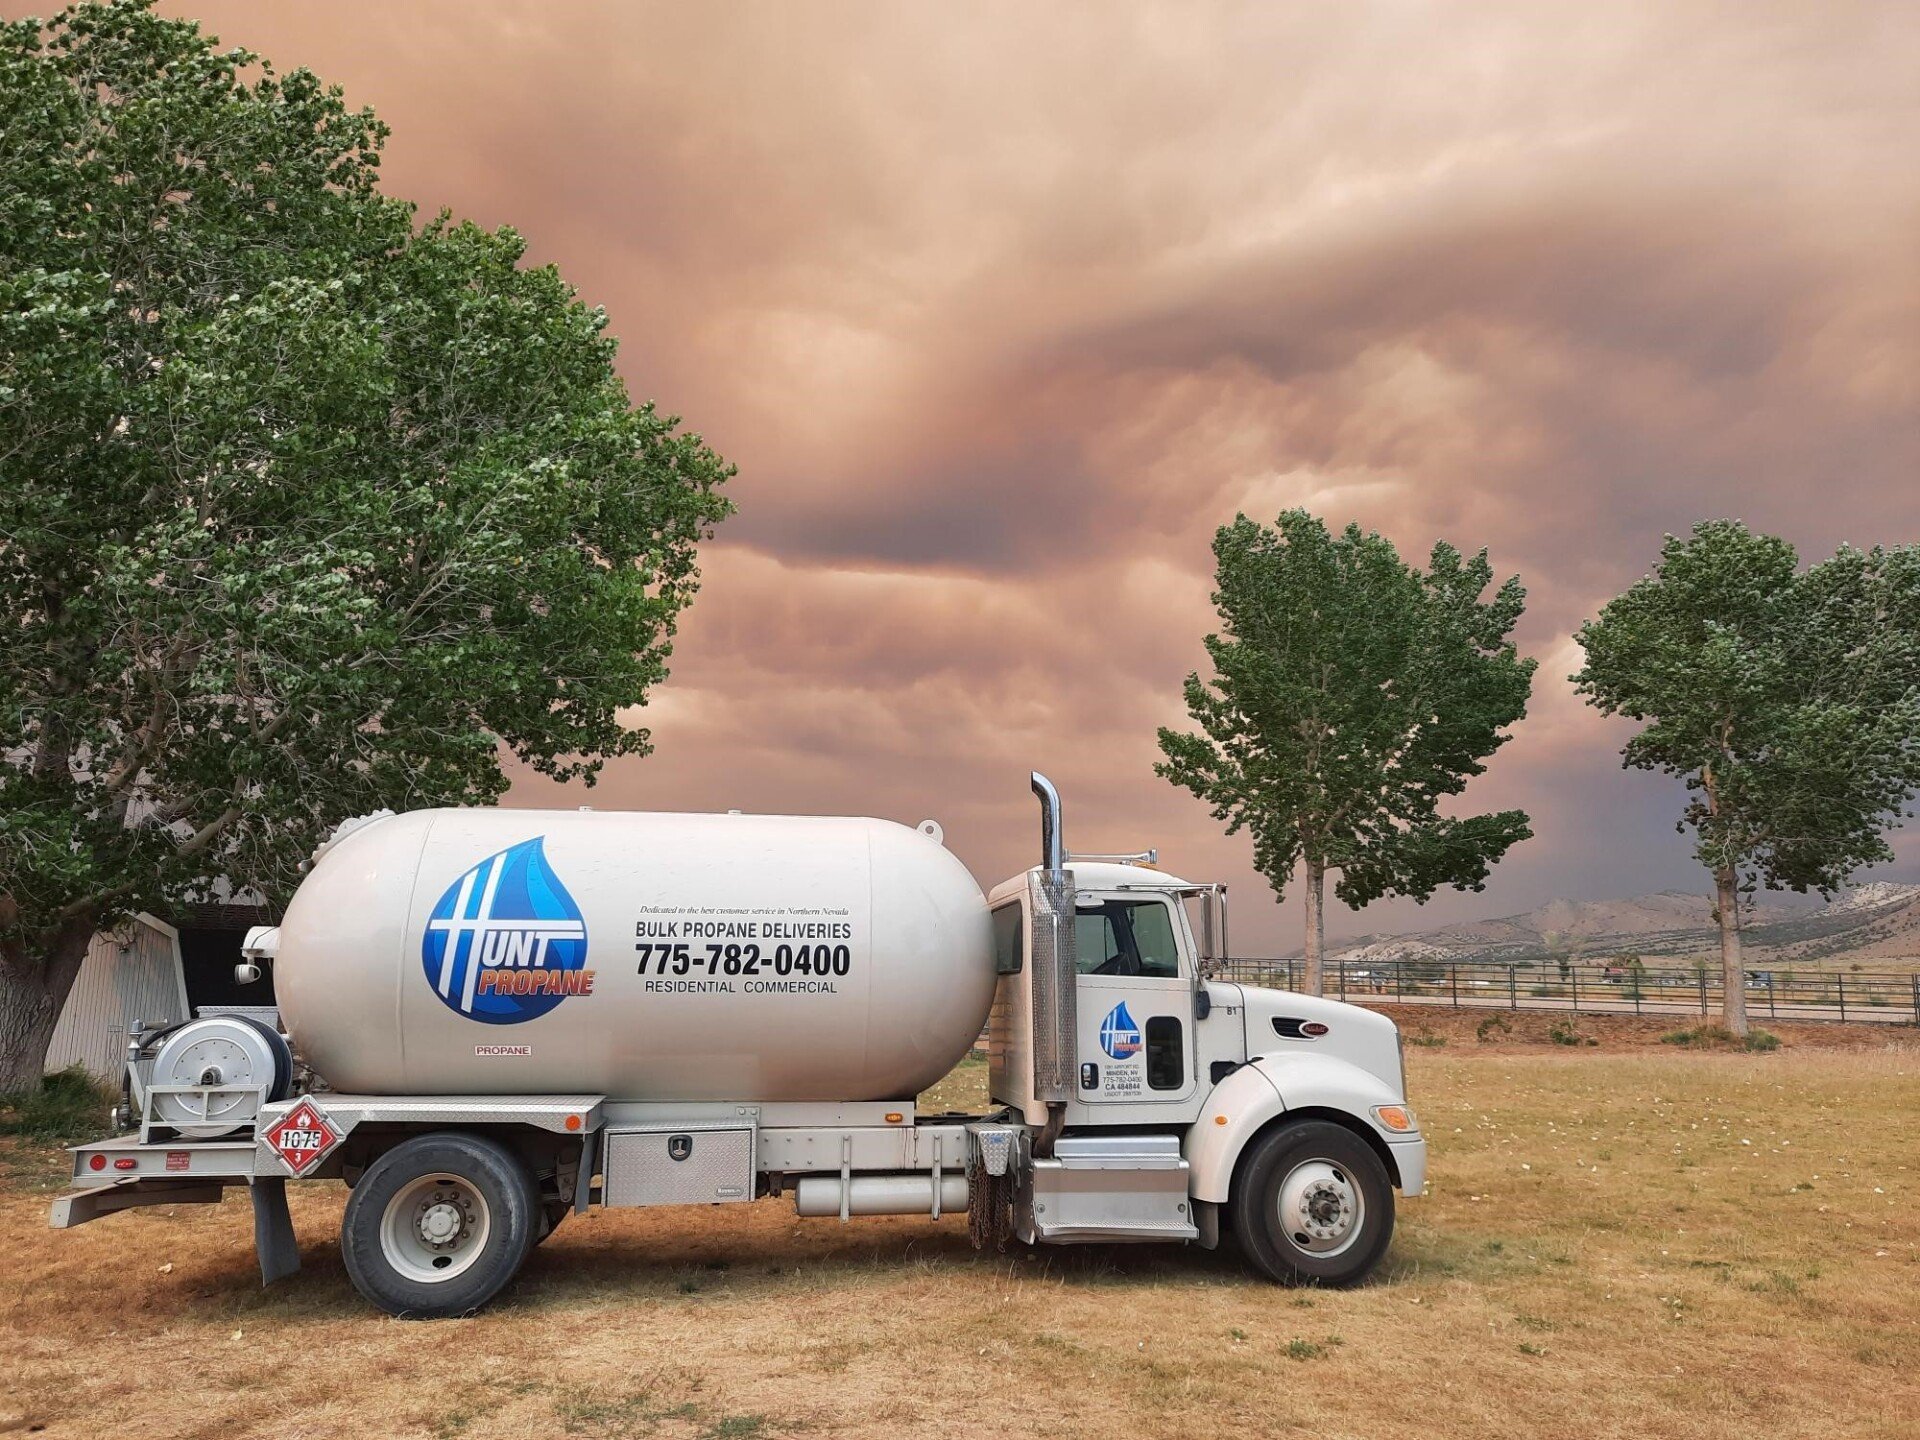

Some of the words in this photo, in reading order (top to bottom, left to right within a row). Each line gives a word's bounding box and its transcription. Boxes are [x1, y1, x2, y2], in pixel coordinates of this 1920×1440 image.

[640, 905, 678, 914] Dedicated
[678, 906, 686, 914] to
[687, 906, 700, 914] the
[700, 906, 715, 914] best
[751, 907, 776, 915] service
[787, 907, 820, 915] Northern
[821, 907, 849, 916] Nevada
[429, 851, 584, 1013] HUNT
[636, 921, 678, 937] BULK
[683, 922, 757, 938] PROPANE
[762, 923, 851, 939] DELIVERIES
[635, 943, 850, 976] 775-782-0400
[477, 969, 595, 996] PROPANE
[645, 981, 736, 993] RESIDENTIAL
[744, 981, 838, 993] COMMERCIAL
[476, 1046, 530, 1055] PROPANE
[1105, 1083, 1116, 1091] CA
[284, 1131, 320, 1148] 1075
[295, 1152, 301, 1163] 3
